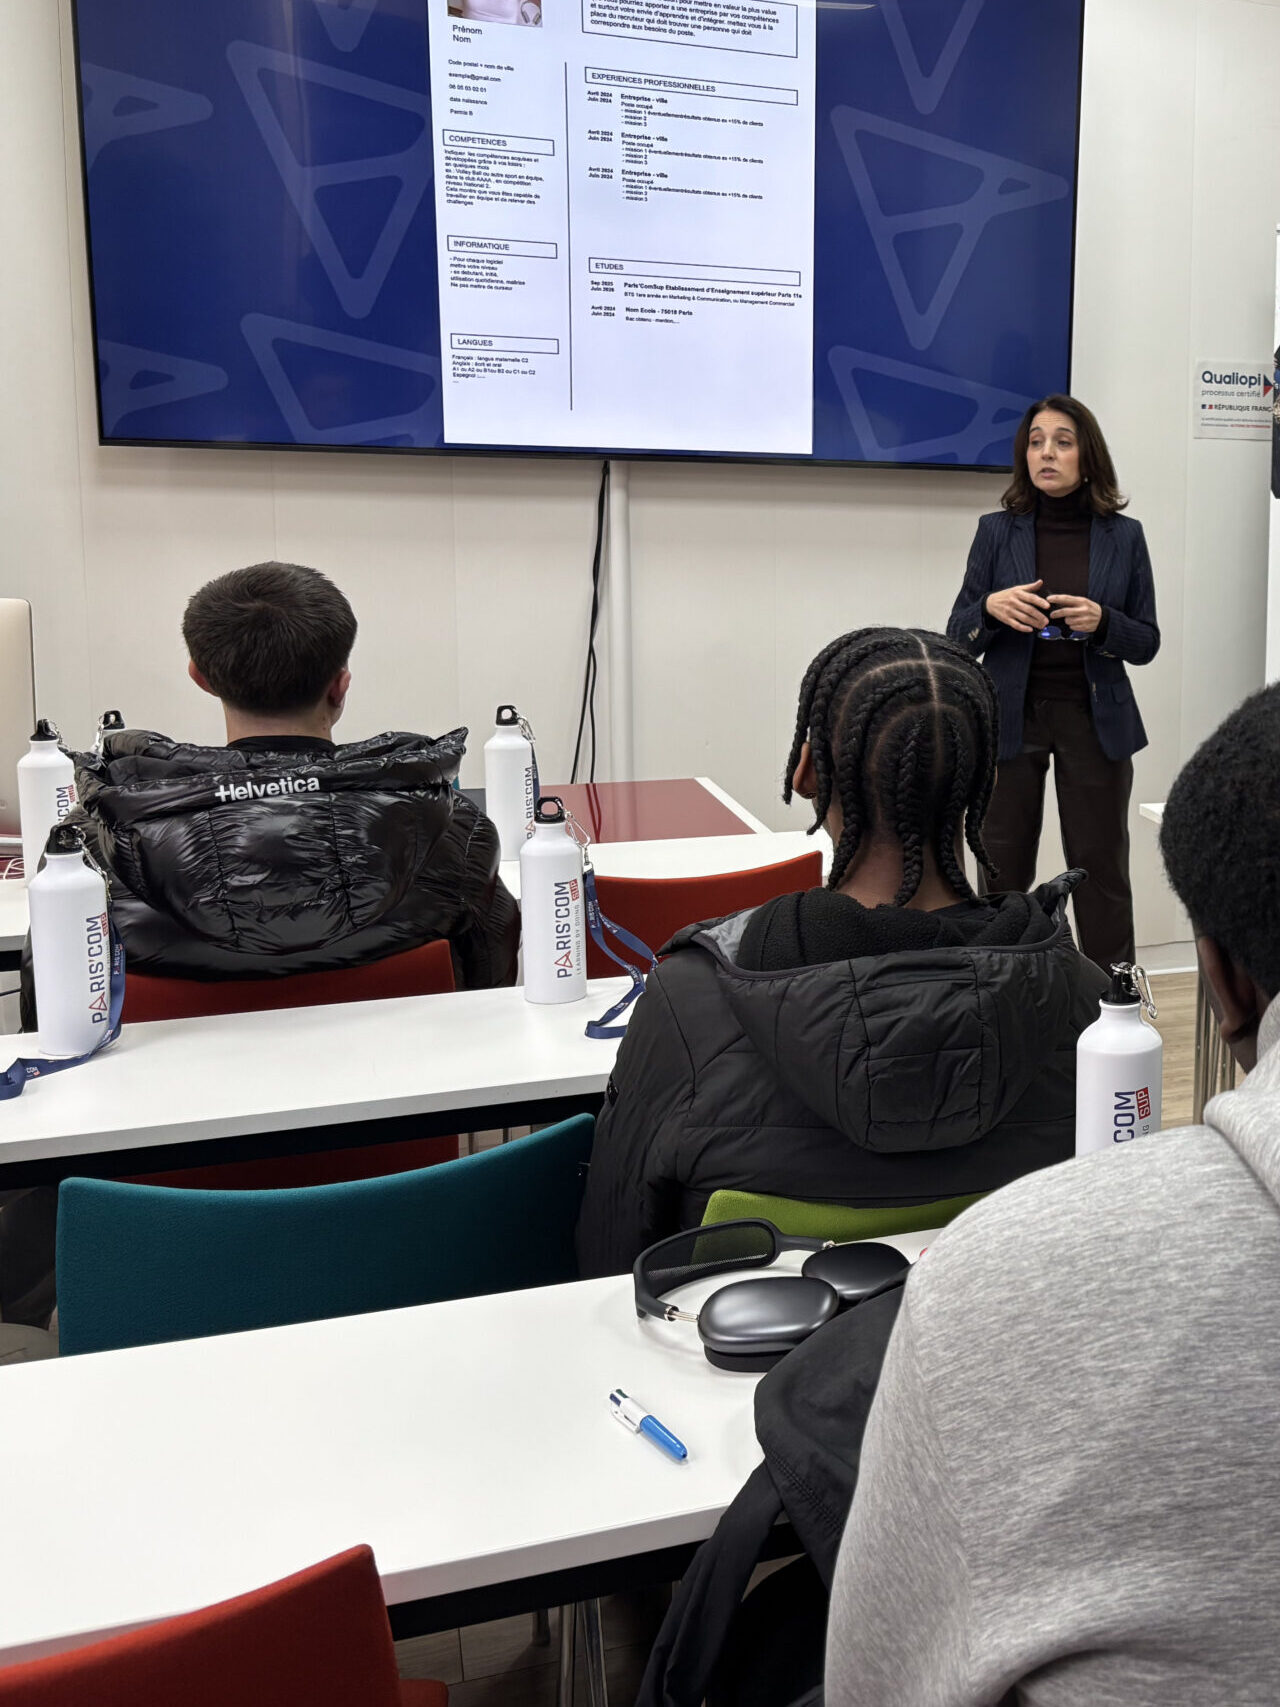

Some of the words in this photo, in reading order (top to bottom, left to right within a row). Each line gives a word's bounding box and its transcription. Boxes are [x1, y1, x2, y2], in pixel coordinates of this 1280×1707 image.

[689, 8, 718, 16] entreprise
[452, 24, 483, 35] Prénom
[590, 19, 630, 29] correspondre
[644, 25, 667, 33] besoins
[668, 20, 689, 28] trouver
[703, 24, 730, 33] personne
[453, 34, 471, 43] Nom
[592, 72, 642, 84] EXPERIENCES
[644, 78, 716, 92] PROFESSIONNELLES
[620, 93, 651, 102] Entreprise
[449, 135, 507, 146] COMPETENCES
[621, 132, 651, 140] Entreprise
[621, 169, 651, 177] Entreprise
[454, 241, 509, 250] INFORMATIQUE
[595, 262, 624, 270] ETUDES
[1202, 370, 1261, 389] Qualiopi
[1214, 404, 1250, 412] RÉPUBLIQUE
[215, 777, 320, 802] Helvetica
[554, 881, 573, 979] PARIS'COM
[86, 916, 108, 1024] PARIS'COM
[1136, 1089, 1150, 1118] SUP
